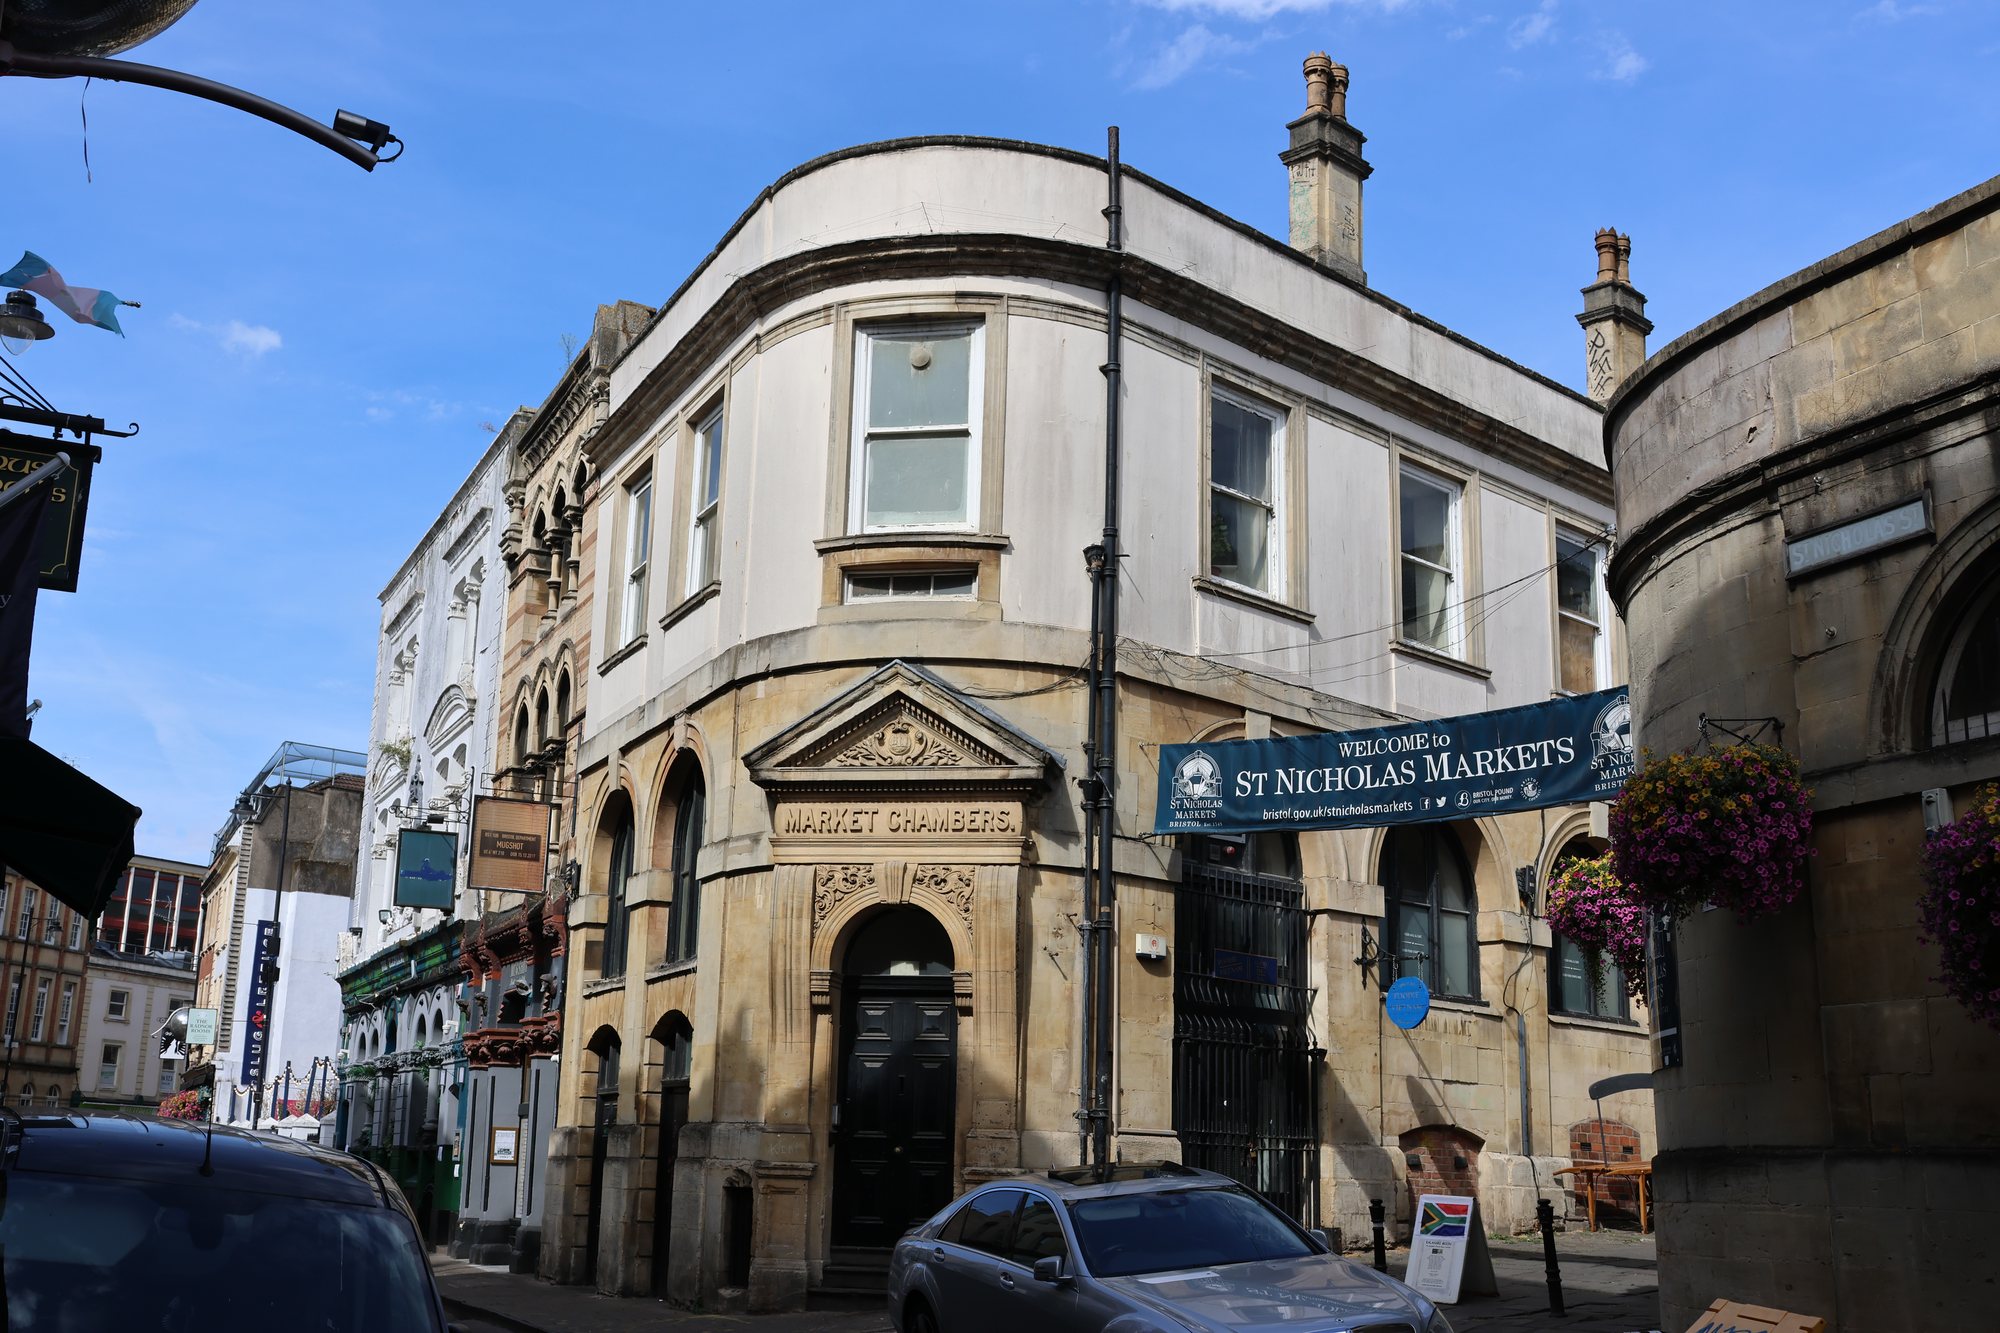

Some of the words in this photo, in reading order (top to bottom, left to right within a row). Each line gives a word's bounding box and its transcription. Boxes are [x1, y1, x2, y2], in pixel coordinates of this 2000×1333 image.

[1813, 518, 1896, 560] NICHOLAS
[1339, 733, 1430, 759] WELCOME
[1432, 733, 1451, 748] to
[1235, 770, 1268, 798] ST
[1274, 759, 1416, 795] NICHOLAS
[1423, 736, 1576, 783] MARKETS
[1183, 798, 1223, 809] NICHOLAS
[1472, 790, 1493, 799] BRISTOL
[1494, 787, 1514, 796] POUND
[784, 806, 879, 834] MARKET
[1175, 810, 1217, 819] MARKETS
[1262, 799, 1413, 821] bristol.gov.uk/stnicholasmarkets
[496, 841, 524, 850] MUGSHOT
[249, 1031, 263, 1077] SLUG
